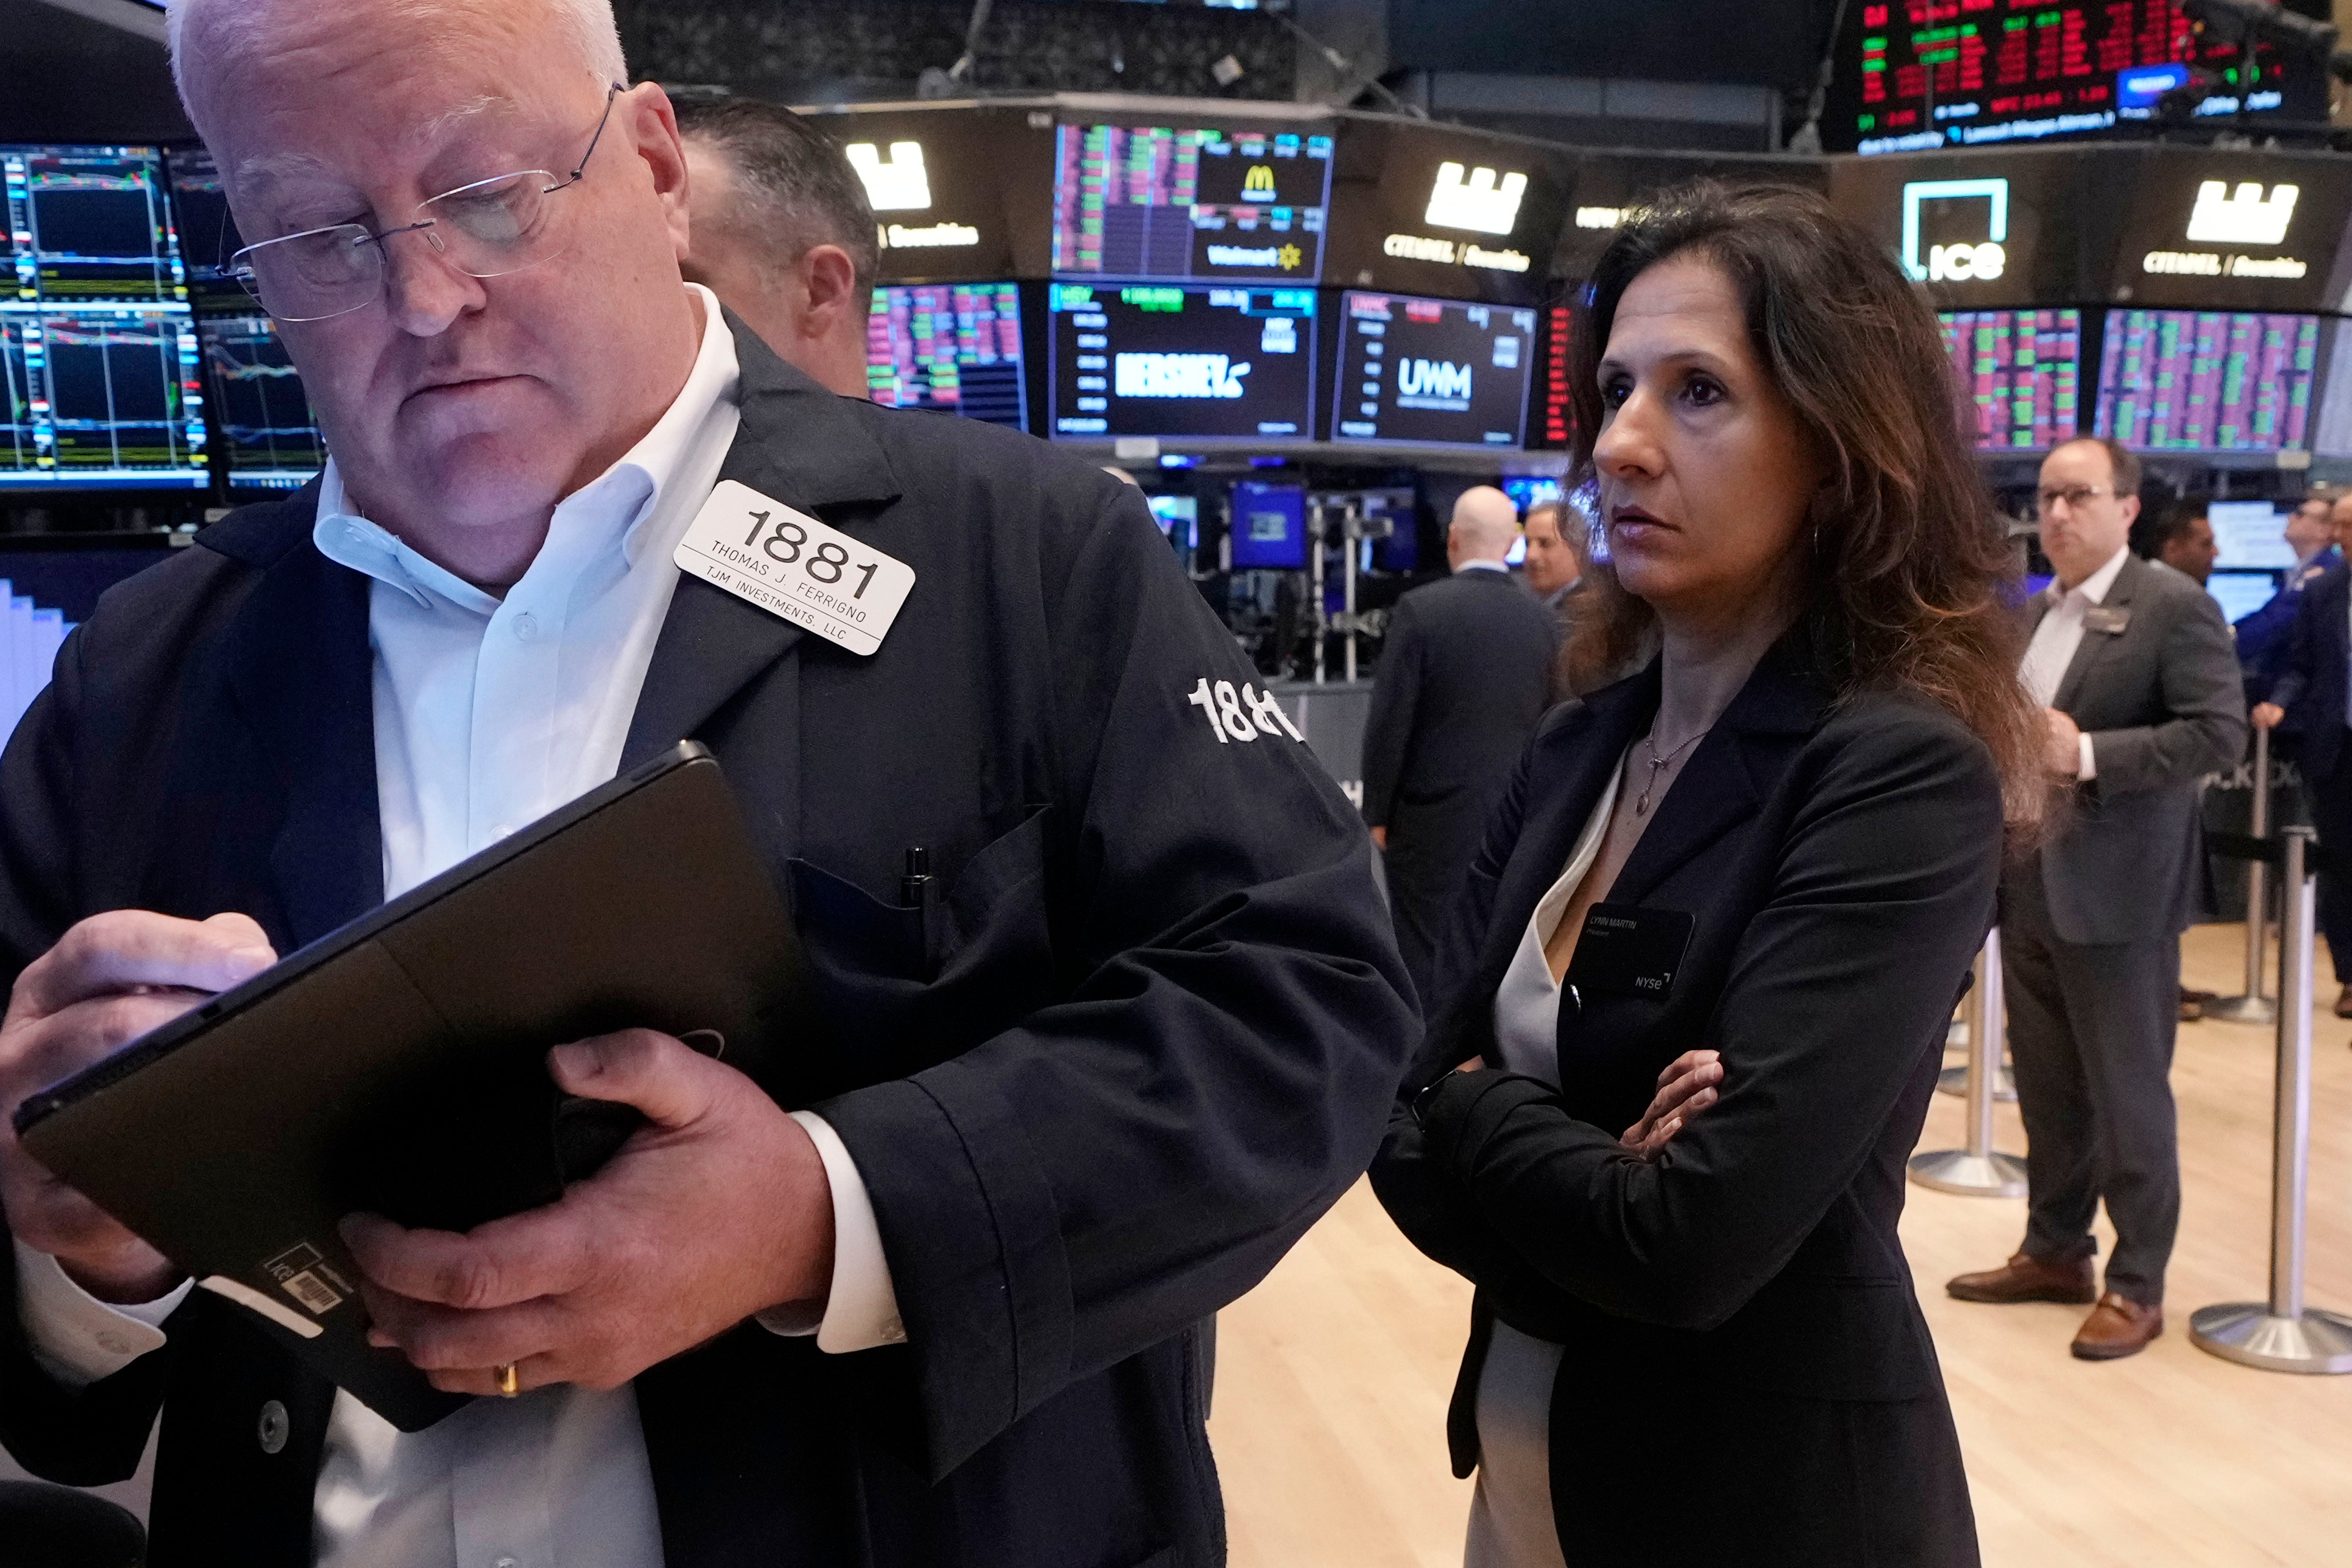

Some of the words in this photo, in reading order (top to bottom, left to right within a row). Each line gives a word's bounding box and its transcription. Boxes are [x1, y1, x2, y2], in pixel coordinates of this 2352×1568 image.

[1398, 357, 1472, 399] UWM
[712, 540, 769, 576] THOMAS
[775, 573, 786, 586] J.
[796, 582, 866, 622] FERRIGNO
[744, 510, 878, 599] 1881
[707, 566, 731, 584] TJM
[824, 622, 846, 640] LLC
[1590, 916, 1609, 926] LYNN
[1609, 918, 1637, 929] MARTIN
